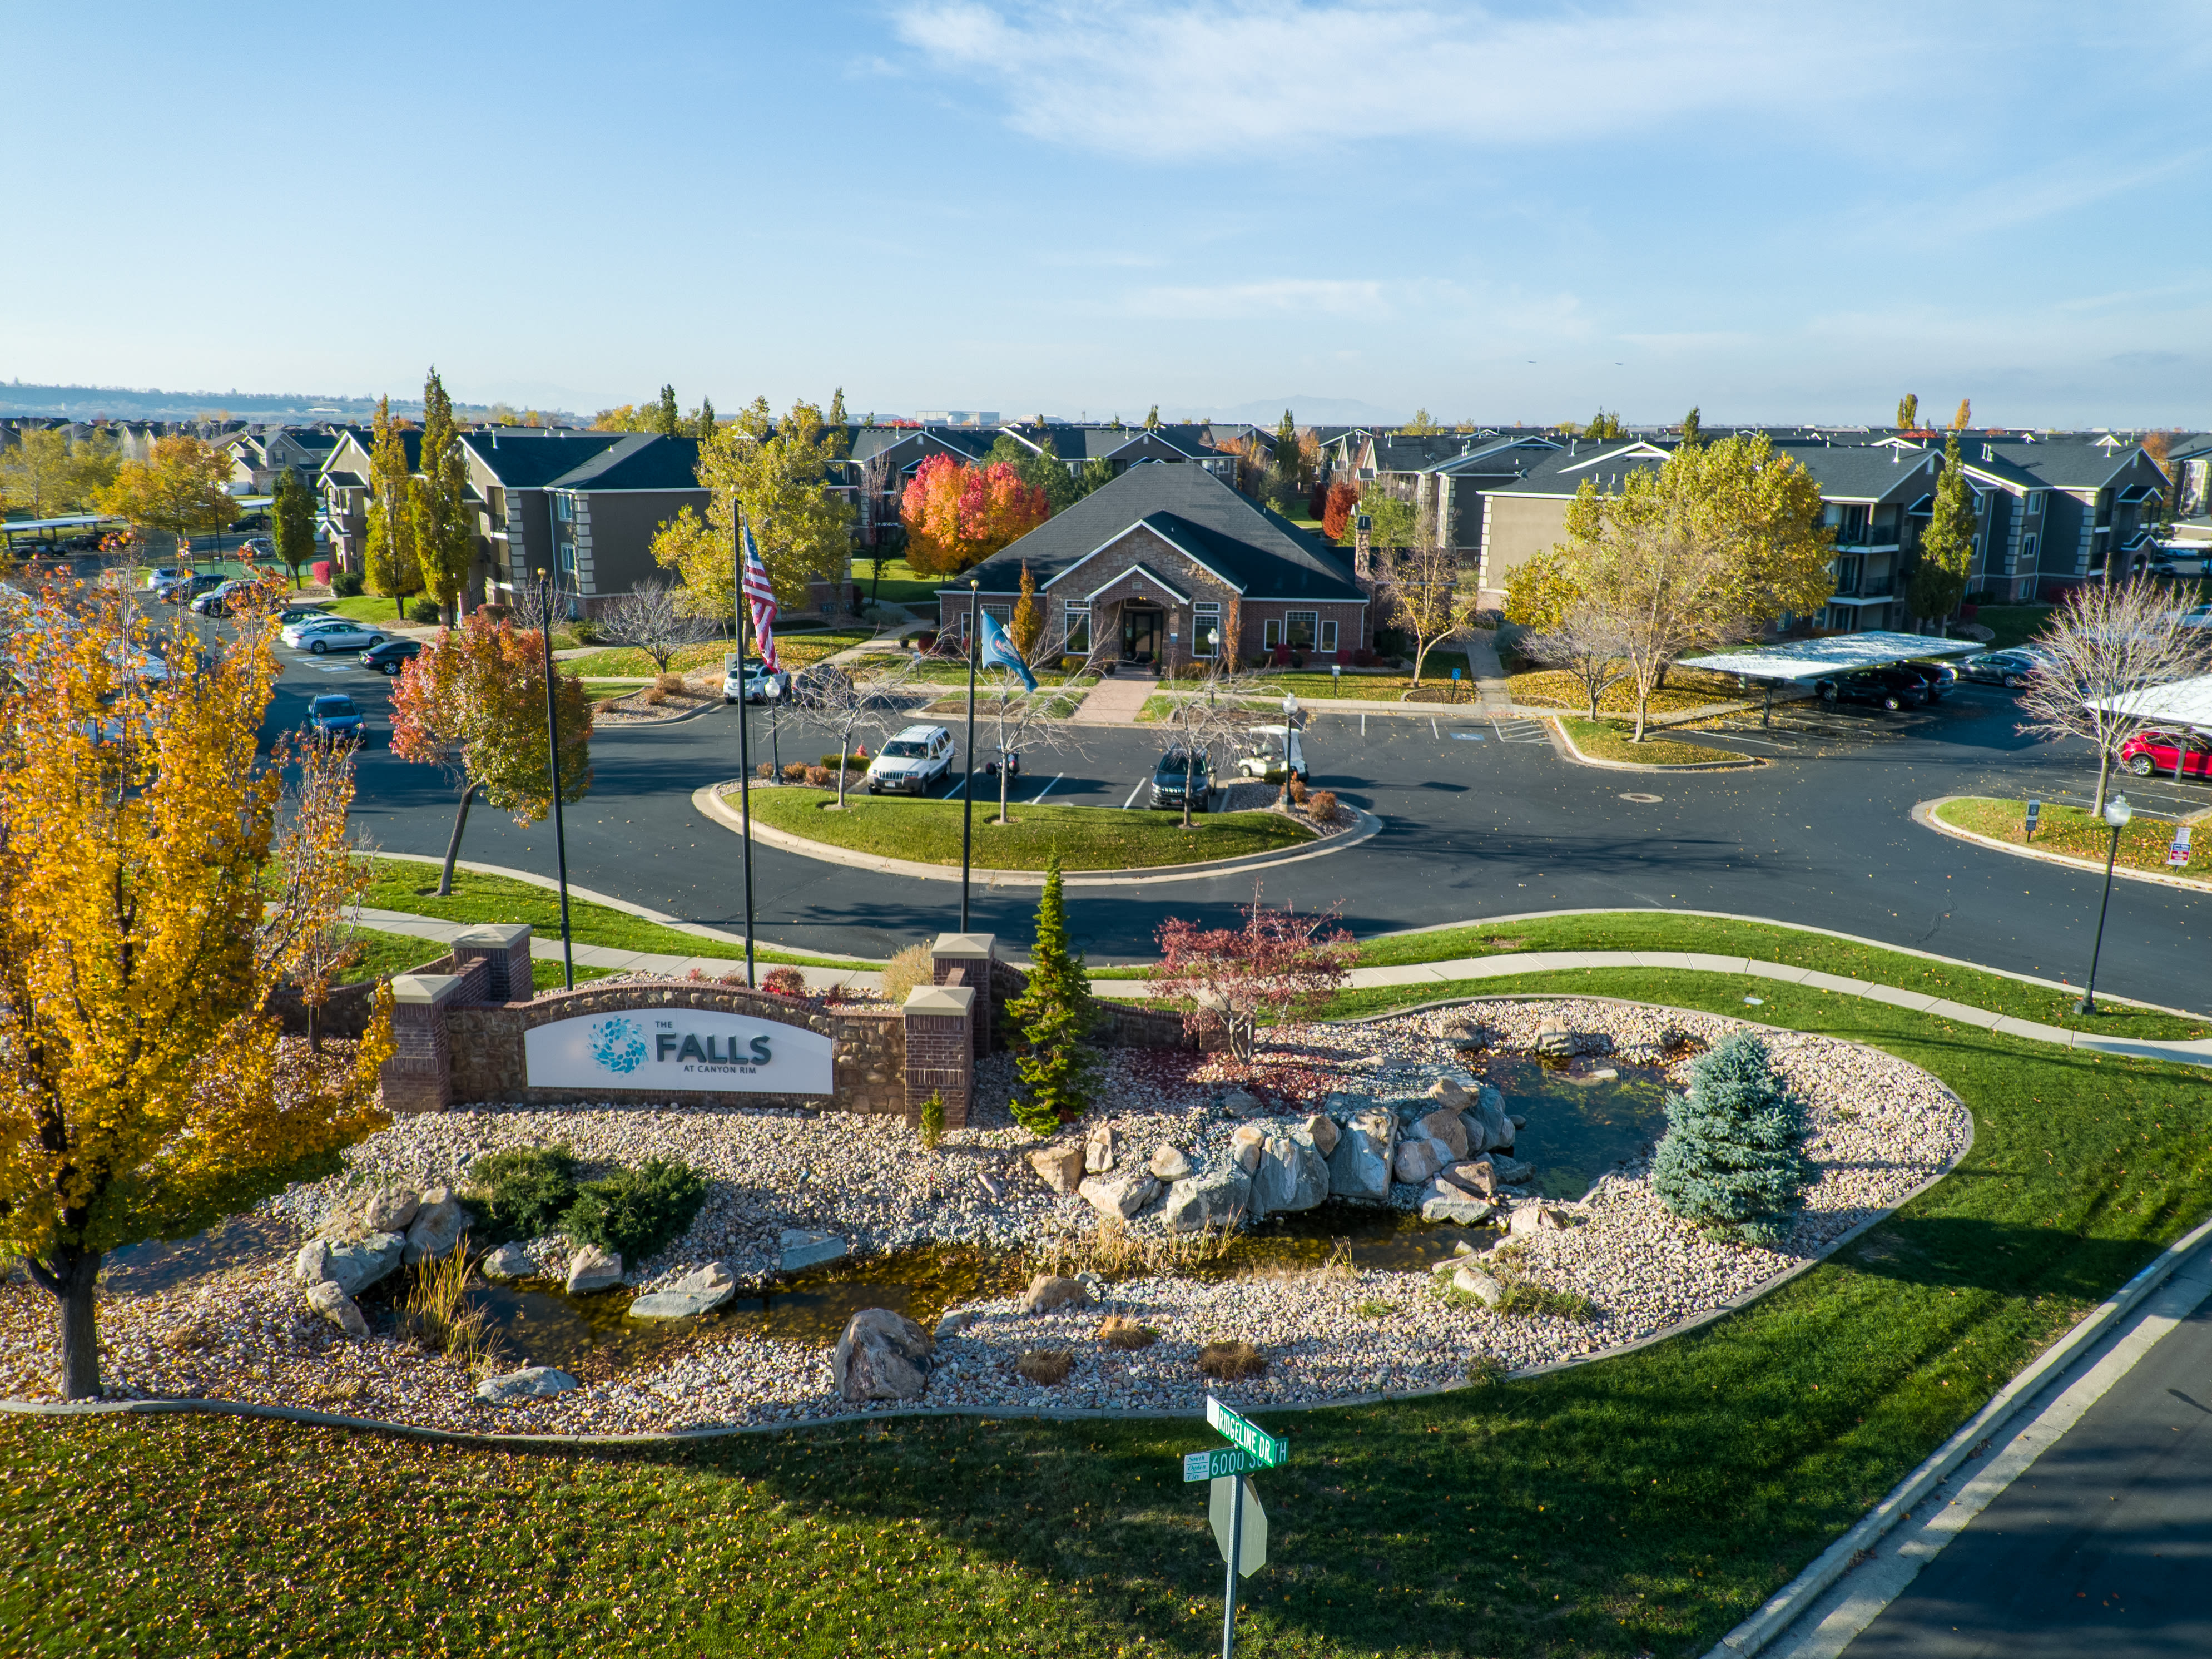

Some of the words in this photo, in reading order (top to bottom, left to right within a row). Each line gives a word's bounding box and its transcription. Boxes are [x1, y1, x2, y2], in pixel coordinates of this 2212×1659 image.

[656, 1032, 772, 1066] FALLS
[1219, 1409, 1257, 1454] RIDGELINE
[1259, 1435, 1272, 1464] DR.
[1211, 1450, 1244, 1475] 6000
[1249, 1441, 1287, 1469] STH
